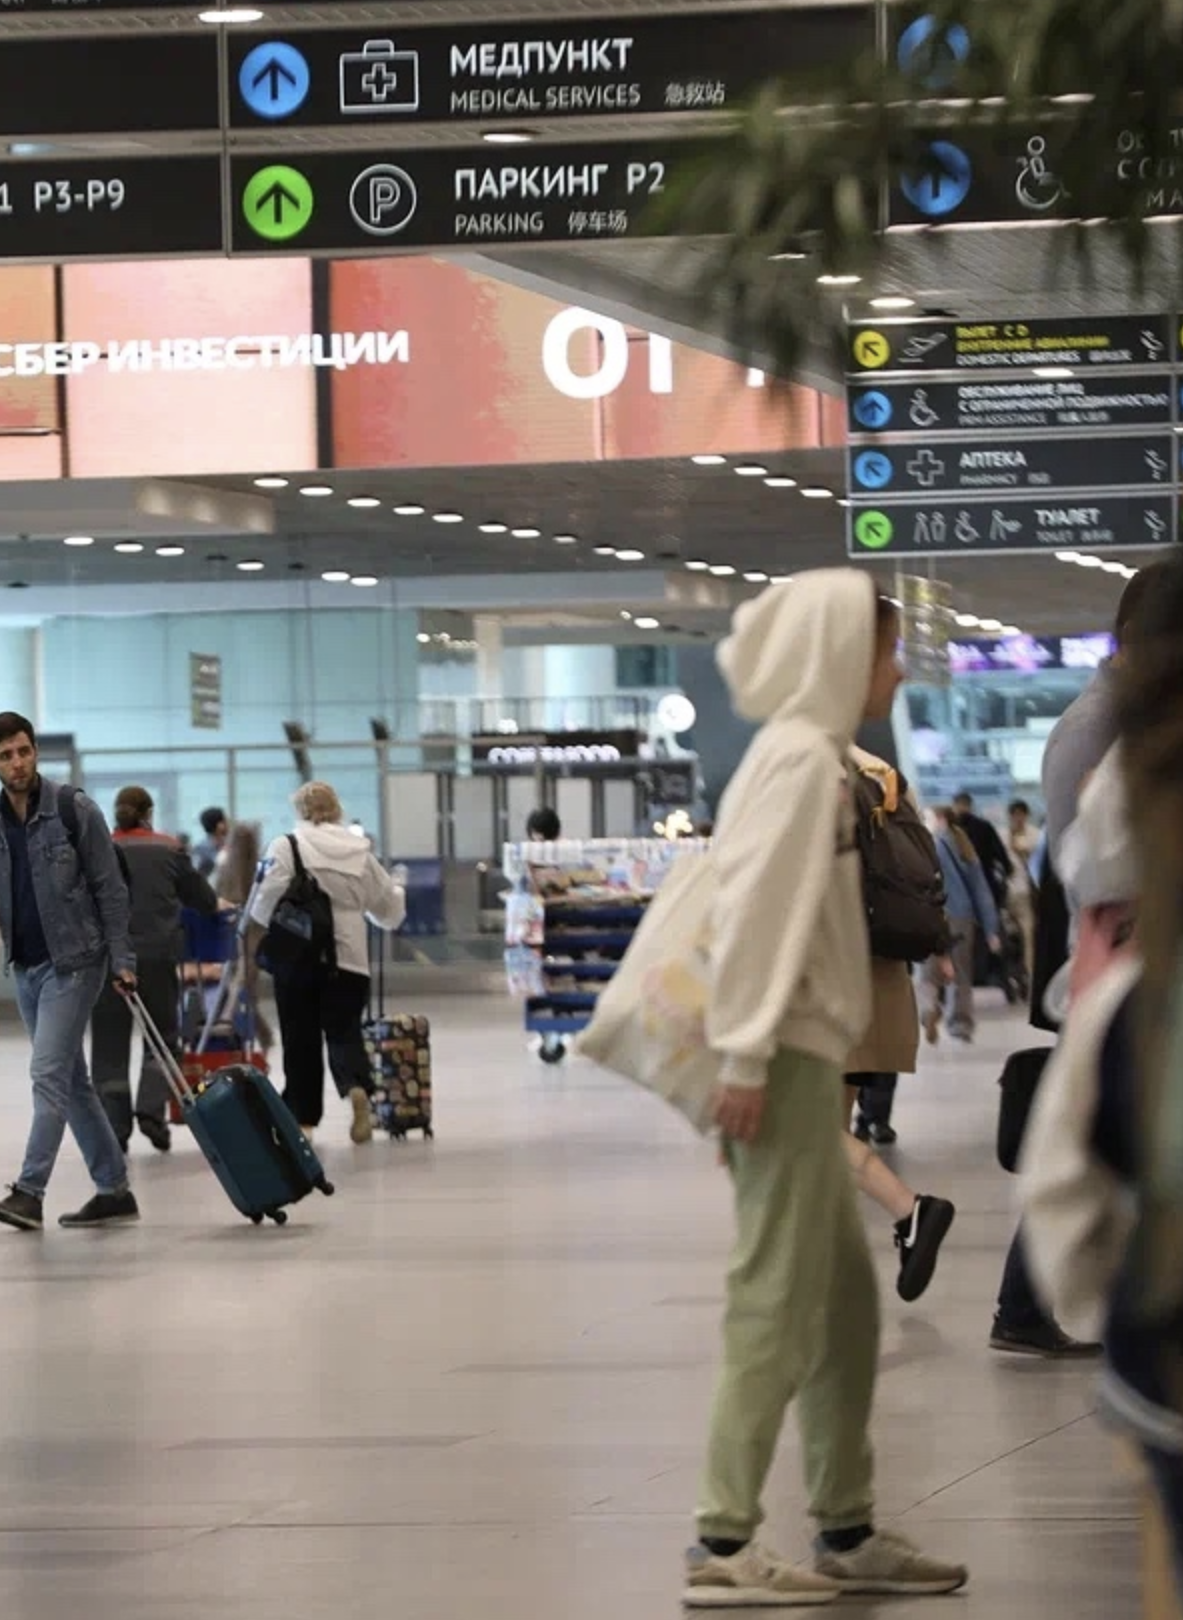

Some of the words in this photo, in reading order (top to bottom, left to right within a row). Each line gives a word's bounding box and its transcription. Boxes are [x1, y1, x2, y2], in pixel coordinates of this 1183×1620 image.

[450, 37, 633, 79] МЕДПУНКТ
[450, 87, 541, 113] MEDICAL
[545, 83, 641, 109] SERVICES
[34, 178, 125, 212] P3-P9
[454, 164, 609, 200] ПАРКИНГ
[626, 161, 665, 195] P2
[454, 211, 545, 236] PARKING
[112, 330, 409, 374] ИНВЕСТИЦИИ
[959, 450, 1027, 468] АПТЕКА
[1034, 508, 1101, 526] ТУАЛЕТ
